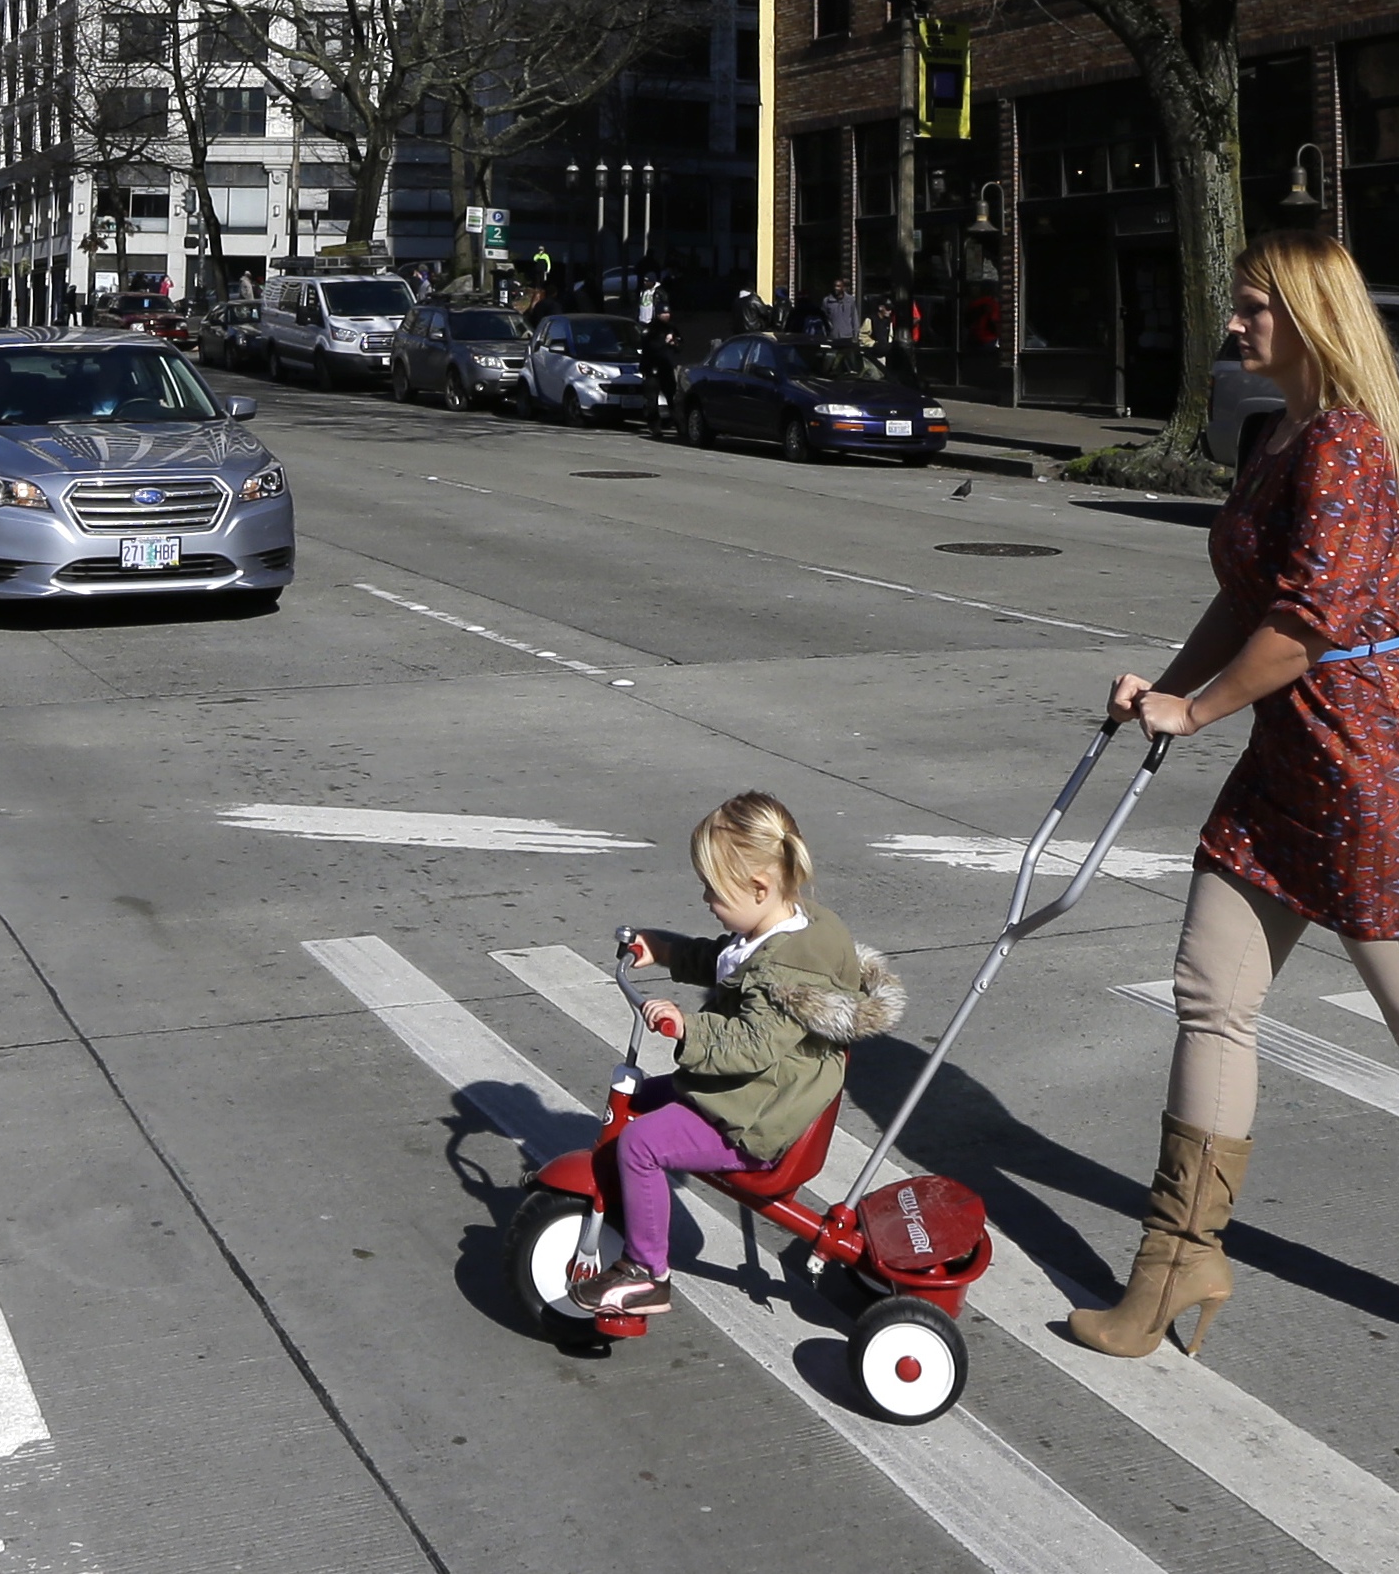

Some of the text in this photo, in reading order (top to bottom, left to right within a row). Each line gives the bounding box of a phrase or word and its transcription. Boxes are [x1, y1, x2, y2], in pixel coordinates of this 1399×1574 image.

[493, 227, 502, 238] 2
[123, 544, 178, 562] 271 HBF
[906, 1223, 934, 1254] RADIO
